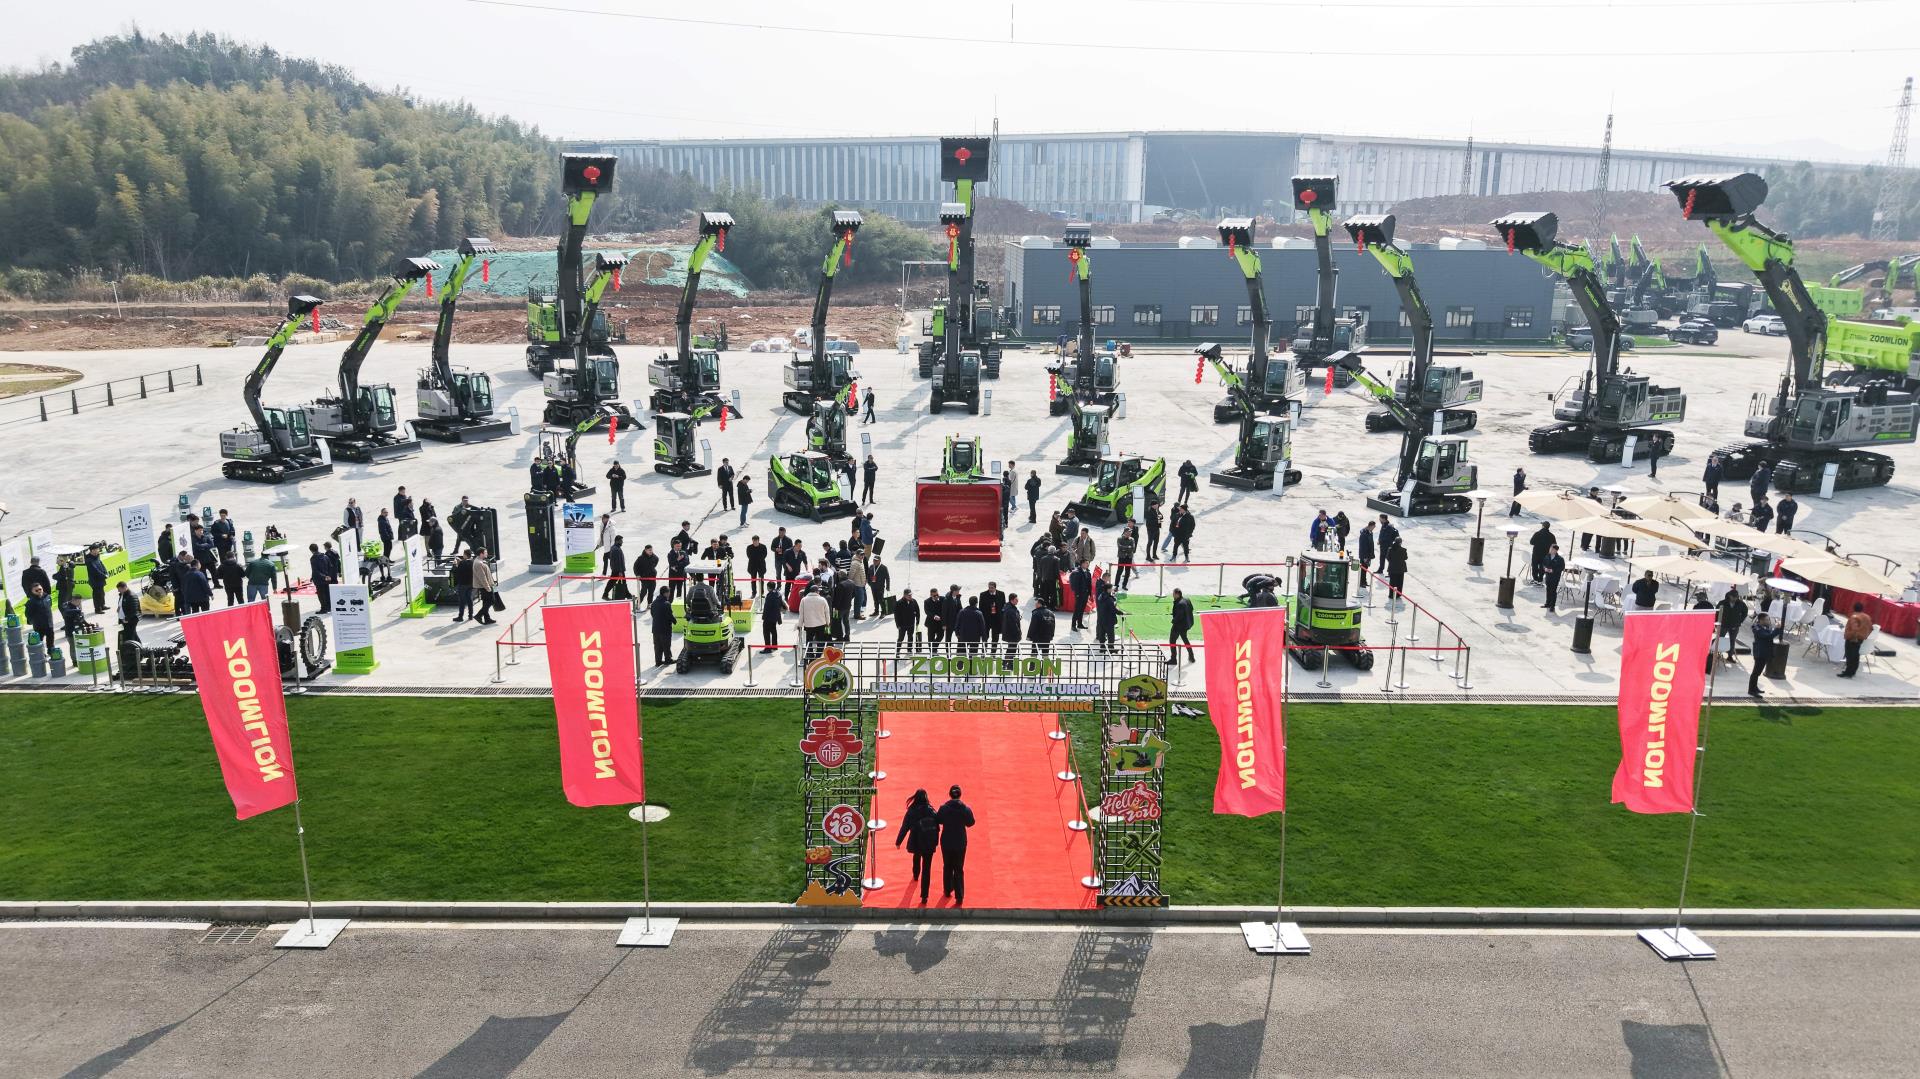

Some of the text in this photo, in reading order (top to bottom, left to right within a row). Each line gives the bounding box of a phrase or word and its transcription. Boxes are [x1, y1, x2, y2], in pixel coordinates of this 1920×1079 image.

[1869, 334, 1909, 346] ZOOMLION
[909, 656, 1061, 676] ZOOMLION
[870, 681, 930, 695] LEADING
[984, 682, 1101, 697] MANUFACTURING
[879, 699, 1094, 713] ZOOMLION GLOBAL OUTSHINING
[821, 743, 842, 762] 福
[832, 788, 877, 796] ZOOMLION
[1104, 790, 1141, 814] Hello
[1126, 804, 1159, 823] 2026
[829, 811, 857, 837] 福
